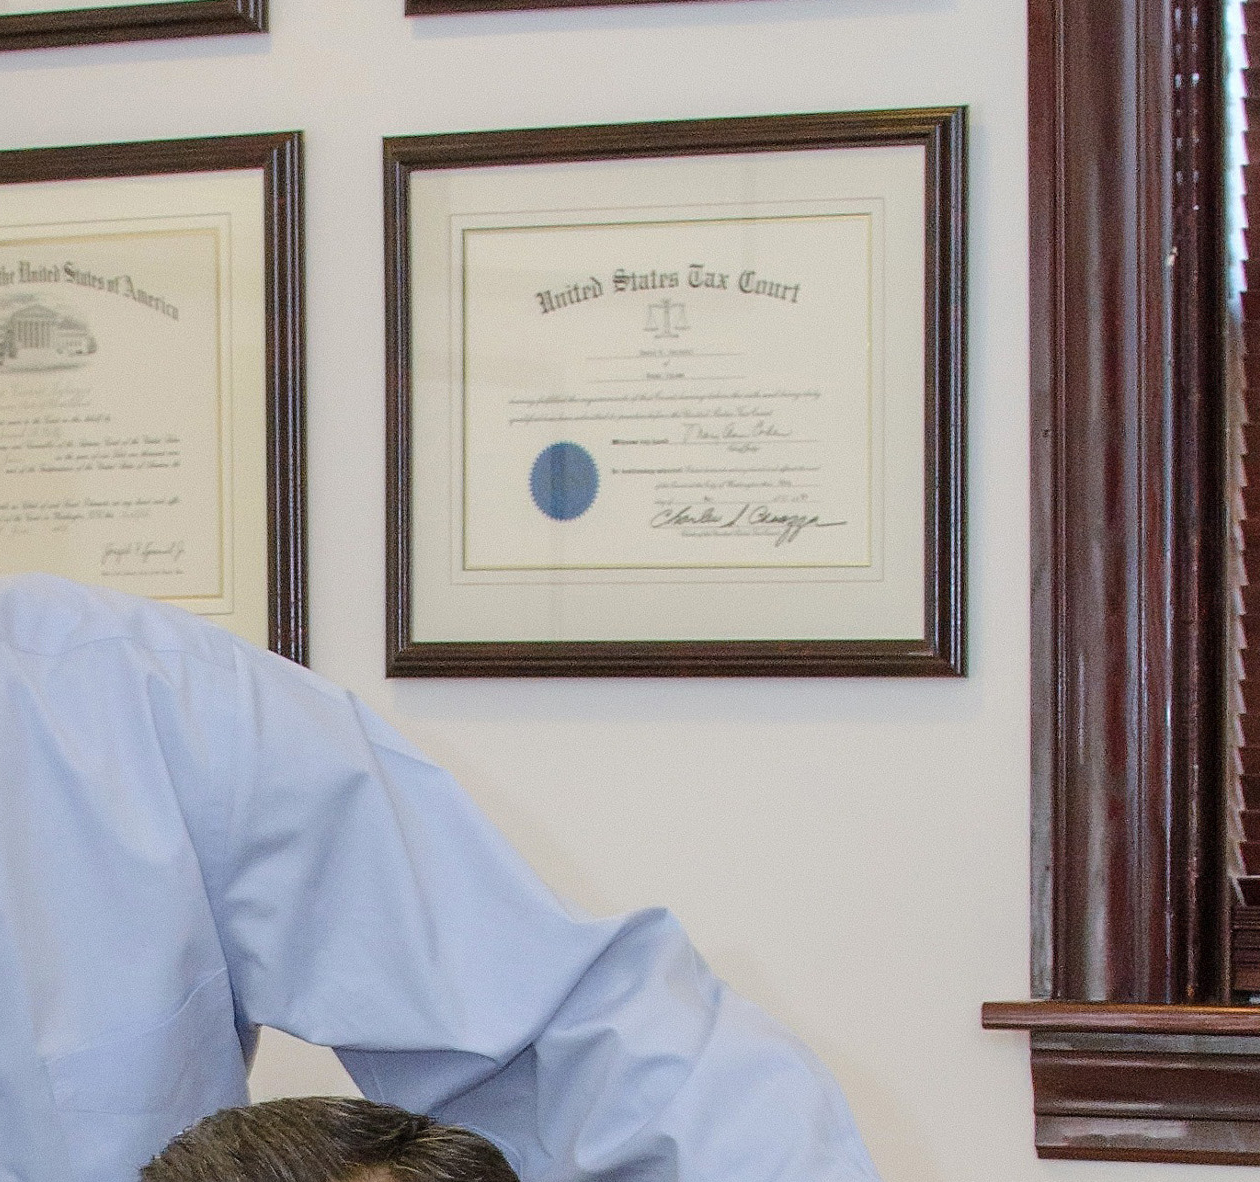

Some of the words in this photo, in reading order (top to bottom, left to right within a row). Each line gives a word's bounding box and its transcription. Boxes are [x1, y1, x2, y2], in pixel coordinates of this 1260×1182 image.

[18, 260, 61, 283] United
[63, 261, 106, 290] States
[122, 274, 180, 321] America
[536, 276, 604, 314] United
[613, 268, 680, 293] States
[689, 263, 730, 290] Tax
[739, 269, 801, 303] Court
